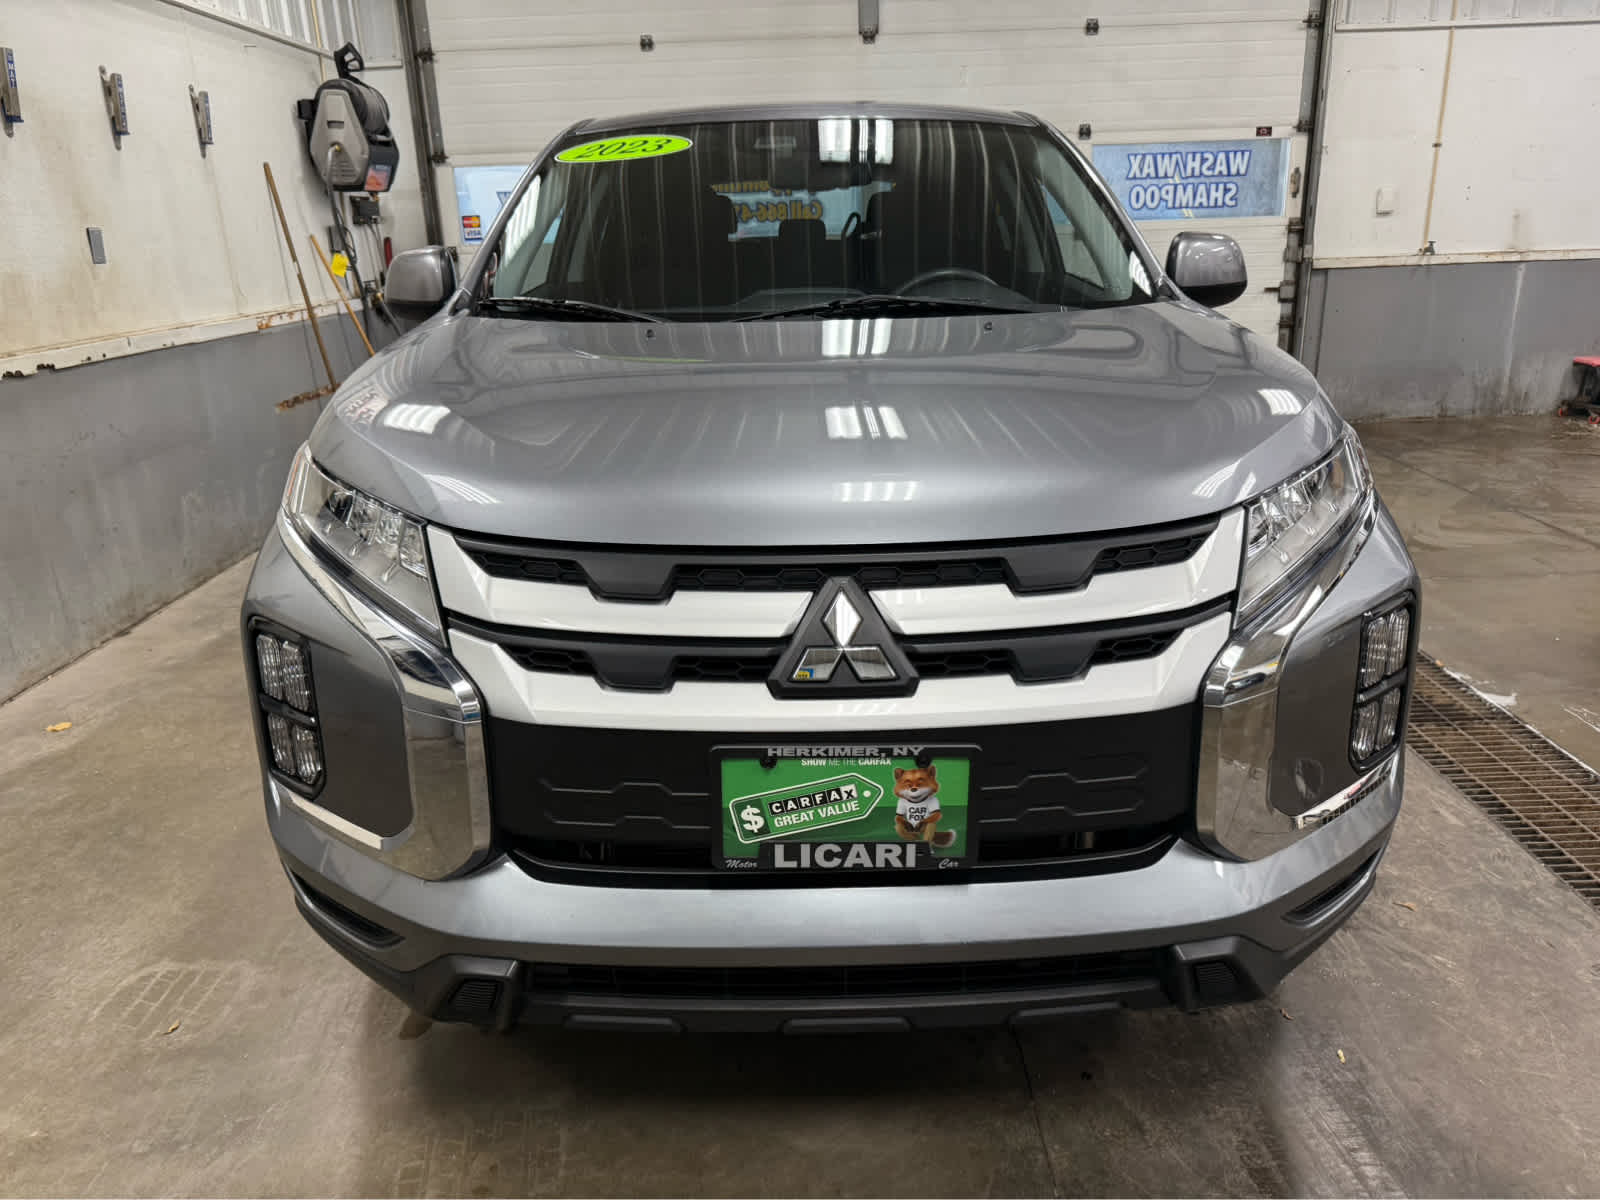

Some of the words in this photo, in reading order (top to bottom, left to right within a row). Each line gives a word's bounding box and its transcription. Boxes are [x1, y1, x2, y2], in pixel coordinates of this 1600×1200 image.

[580, 136, 672, 158] 2023
[767, 747, 887, 758] HERKIMER,
[893, 746, 924, 756] NY
[801, 758, 826, 766] SHOW
[829, 758, 840, 766] ME
[842, 758, 857, 766] THE
[858, 758, 892, 766] CARFAX
[769, 785, 858, 815] CARFAX
[740, 805, 765, 833] $
[774, 810, 815, 828] GREAT
[818, 800, 860, 820] VALUE
[908, 806, 927, 815] CAR
[908, 814, 926, 822] FOX
[725, 858, 758, 869] Motor
[938, 858, 960, 869] Car
[774, 844, 917, 868] LICARI
